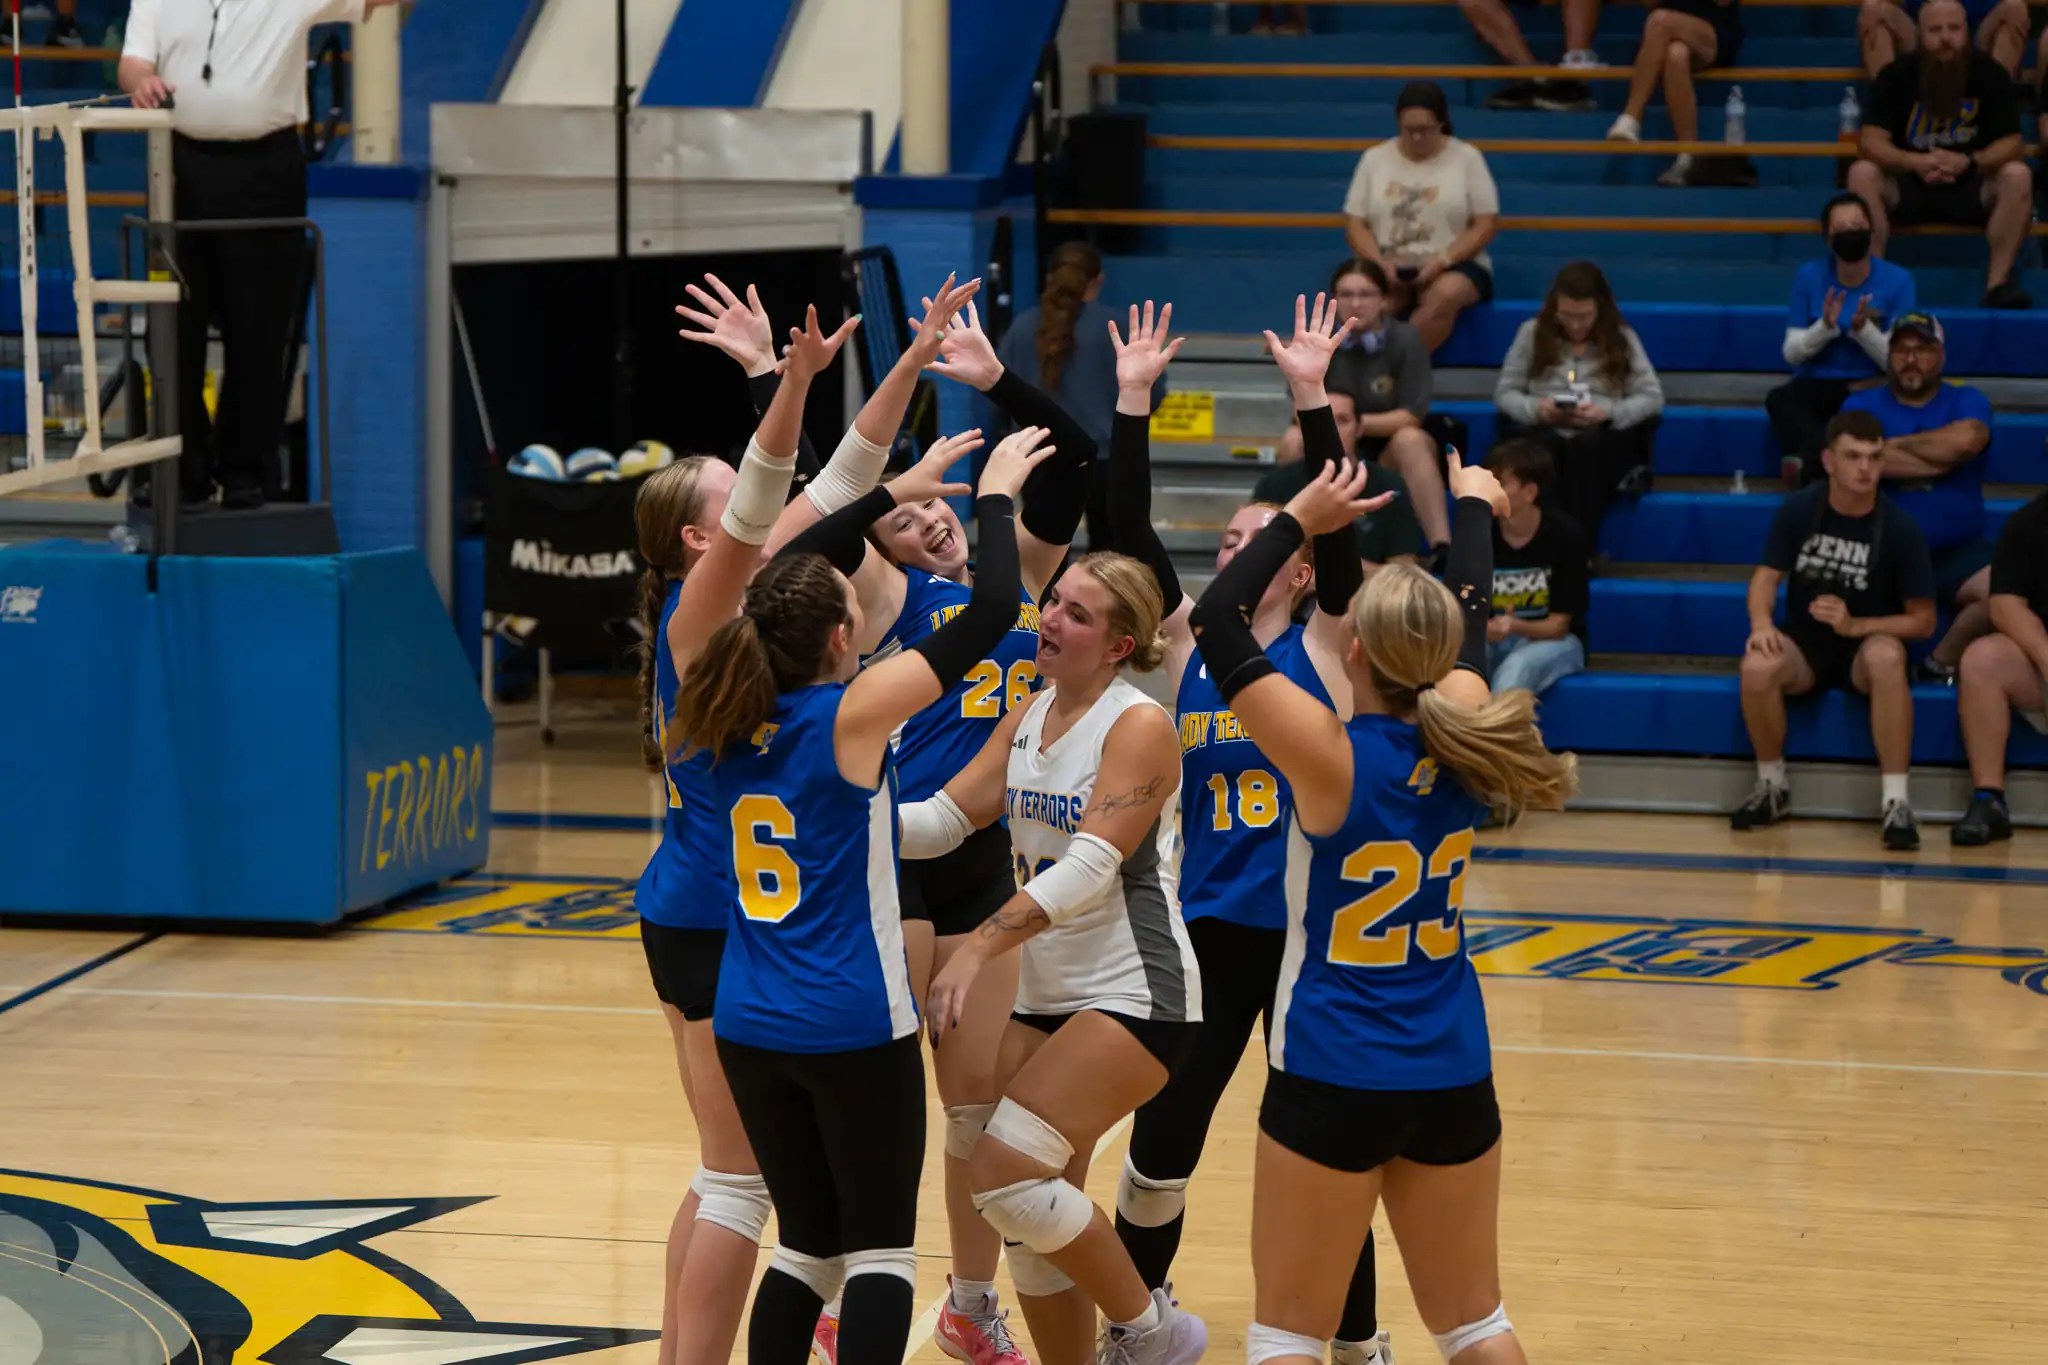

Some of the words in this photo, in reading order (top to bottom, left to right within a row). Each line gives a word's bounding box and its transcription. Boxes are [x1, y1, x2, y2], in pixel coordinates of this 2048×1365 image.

[961, 658, 1037, 718] 26
[1180, 711, 1213, 756] ADY
[361, 743, 483, 874] TERRORS
[1020, 789, 1083, 835] TERRORS
[1206, 769, 1279, 831] 18
[730, 793, 802, 924] 6
[1326, 826, 1476, 968] 23
